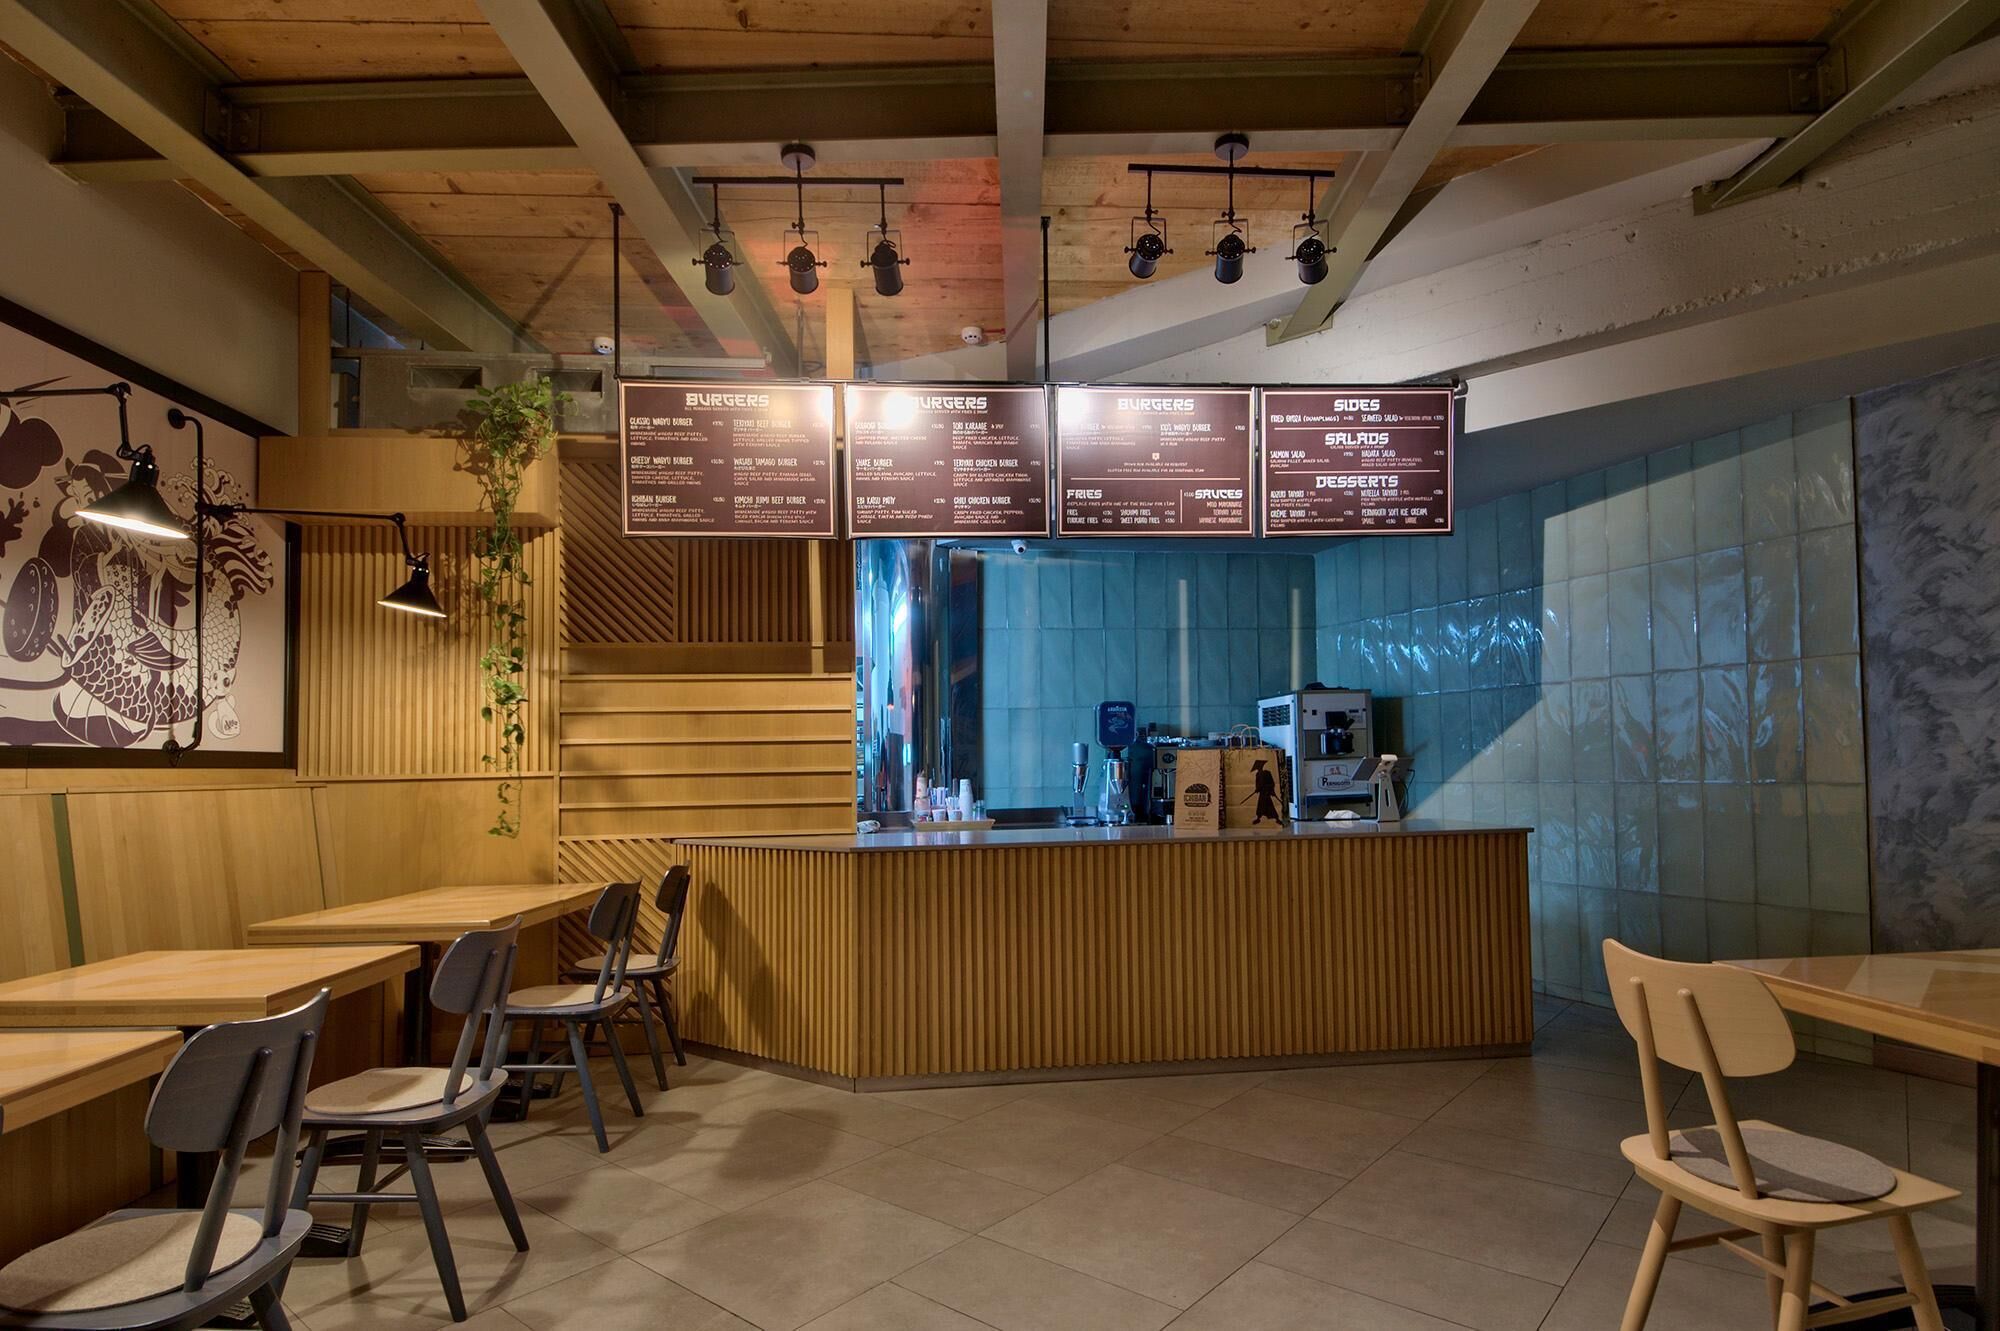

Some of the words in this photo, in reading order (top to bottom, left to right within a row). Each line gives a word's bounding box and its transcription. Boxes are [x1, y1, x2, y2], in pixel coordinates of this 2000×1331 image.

[686, 393, 769, 407] BURGERS
[912, 396, 988, 409] URGERS
[1117, 398, 1195, 411] BURGERS
[1334, 399, 1380, 411] SIDES
[1325, 432, 1389, 445] SALADS
[1315, 475, 1398, 489] DESSERTS
[1067, 489, 1102, 499] FRIES
[1195, 489, 1243, 499] SAUCES
